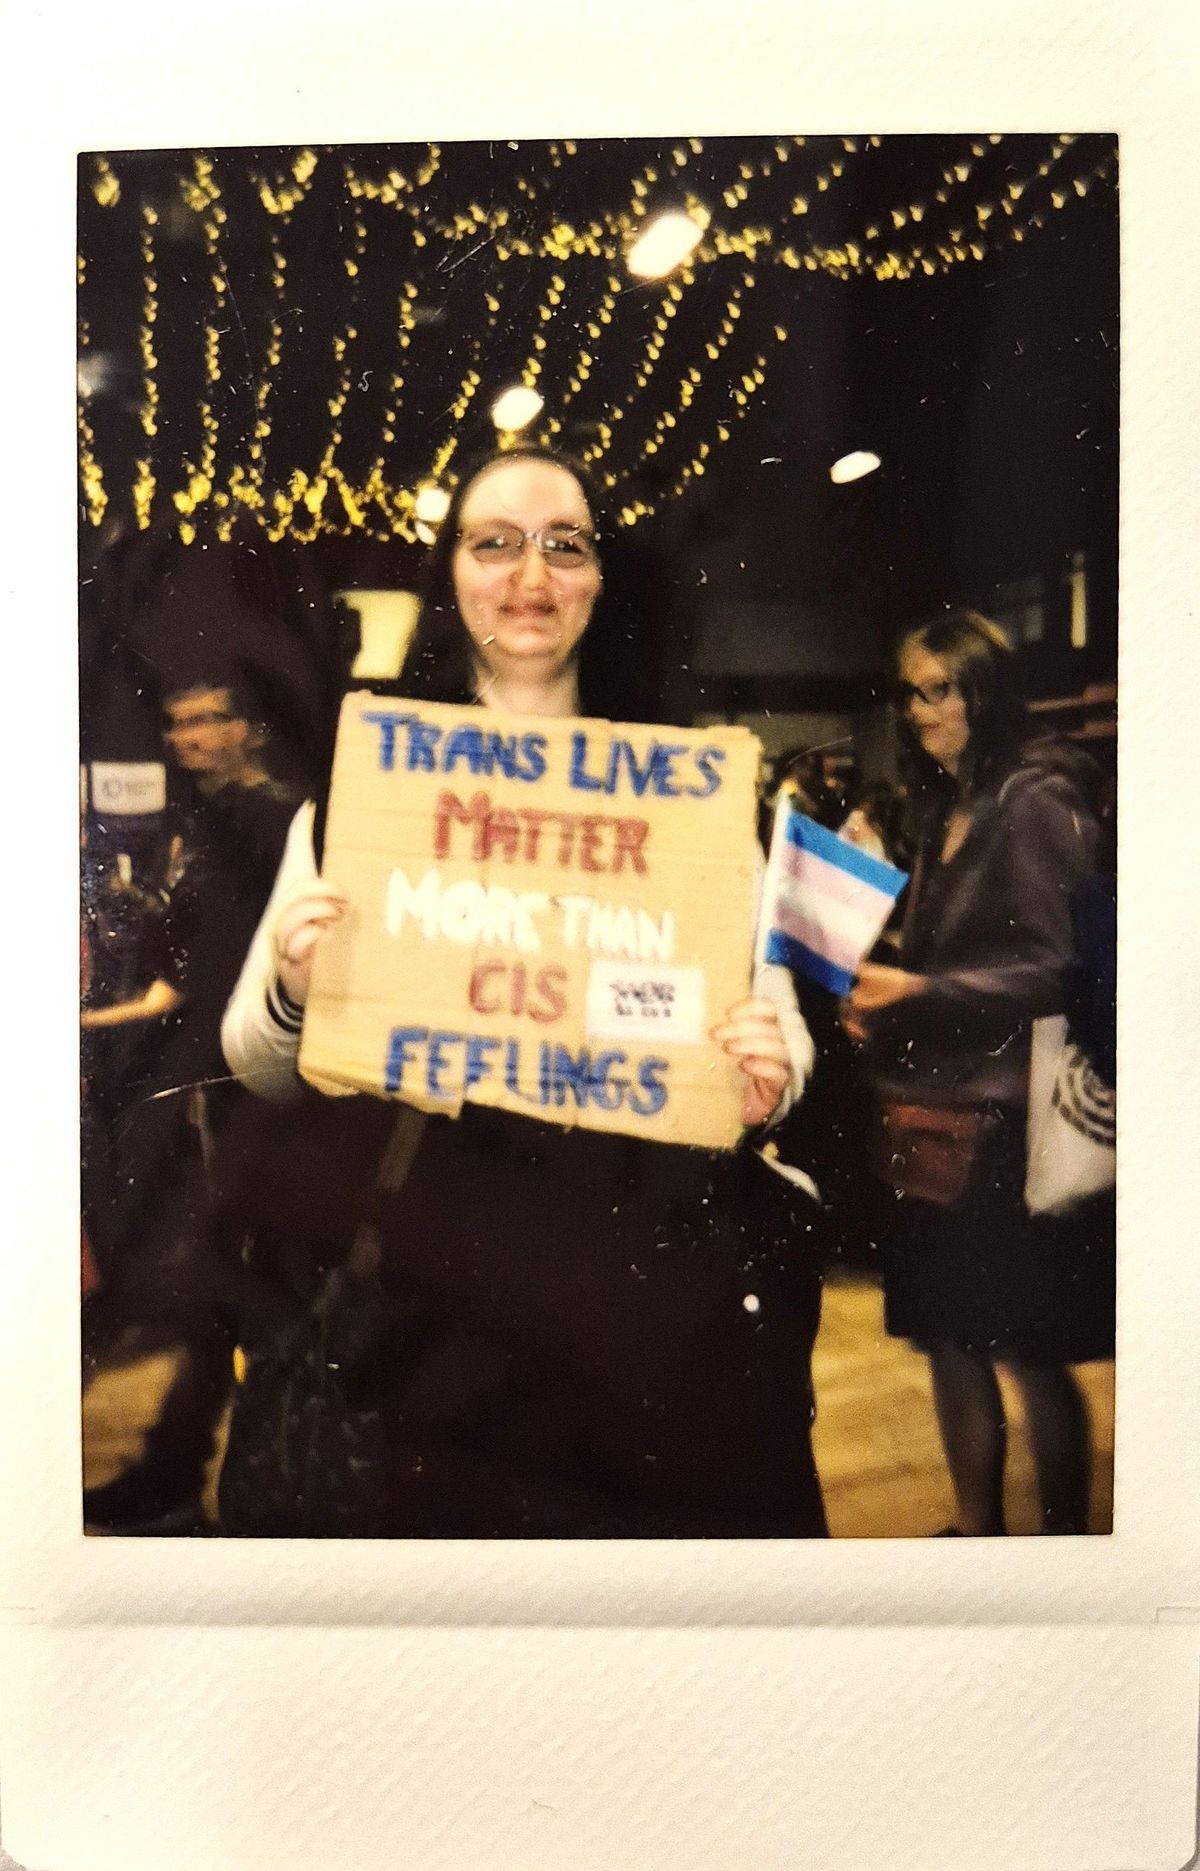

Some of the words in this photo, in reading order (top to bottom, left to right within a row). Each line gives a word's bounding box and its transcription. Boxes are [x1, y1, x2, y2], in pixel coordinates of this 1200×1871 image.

[362, 711, 547, 781] TRANS
[569, 731, 725, 797] LIVES
[434, 790, 650, 875] MATTER
[386, 867, 549, 955] MORE
[556, 894, 675, 964] THAN
[468, 960, 568, 1023] CIS
[385, 1026, 670, 1116] FEELINGS
